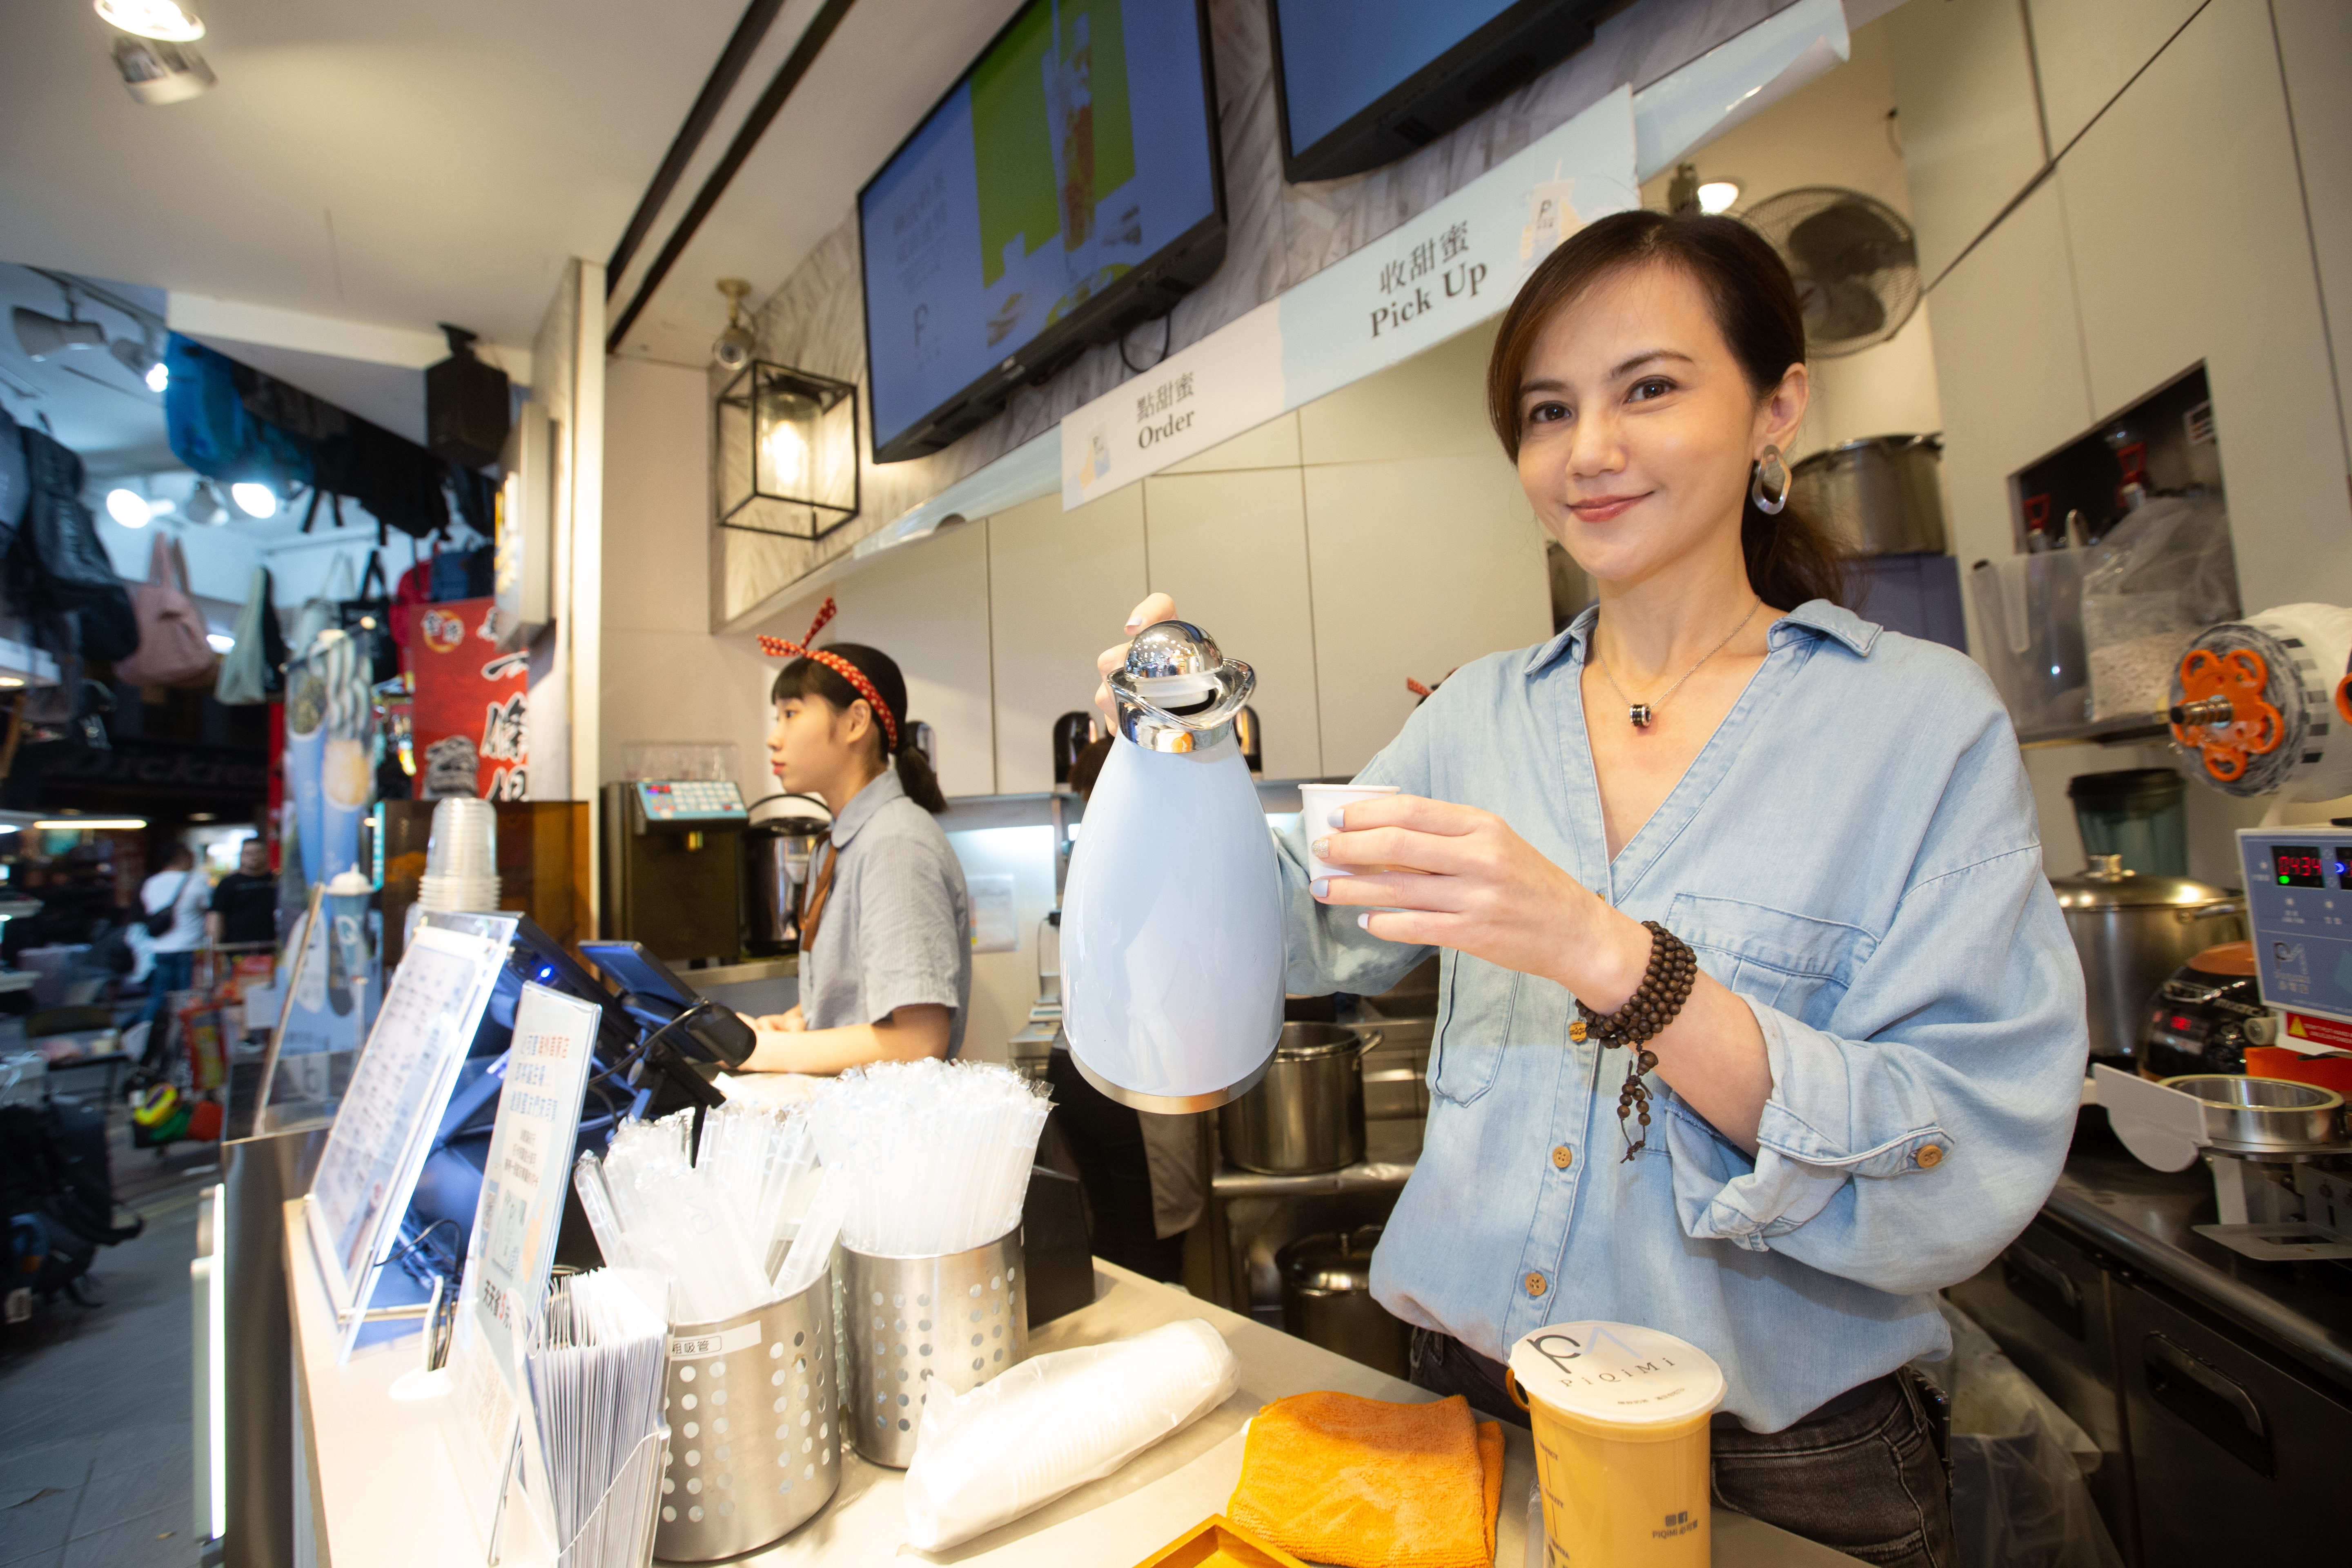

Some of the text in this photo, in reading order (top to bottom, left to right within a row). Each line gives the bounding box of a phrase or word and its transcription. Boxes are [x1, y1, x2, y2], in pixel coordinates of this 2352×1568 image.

[1379, 220, 1469, 294] 收甜蜜
[1370, 262, 1488, 339] Pick Up
[1137, 371, 1194, 423] 點甜蜜
[1138, 410, 1195, 448] Order
[2278, 856, 2322, 876] 0434
